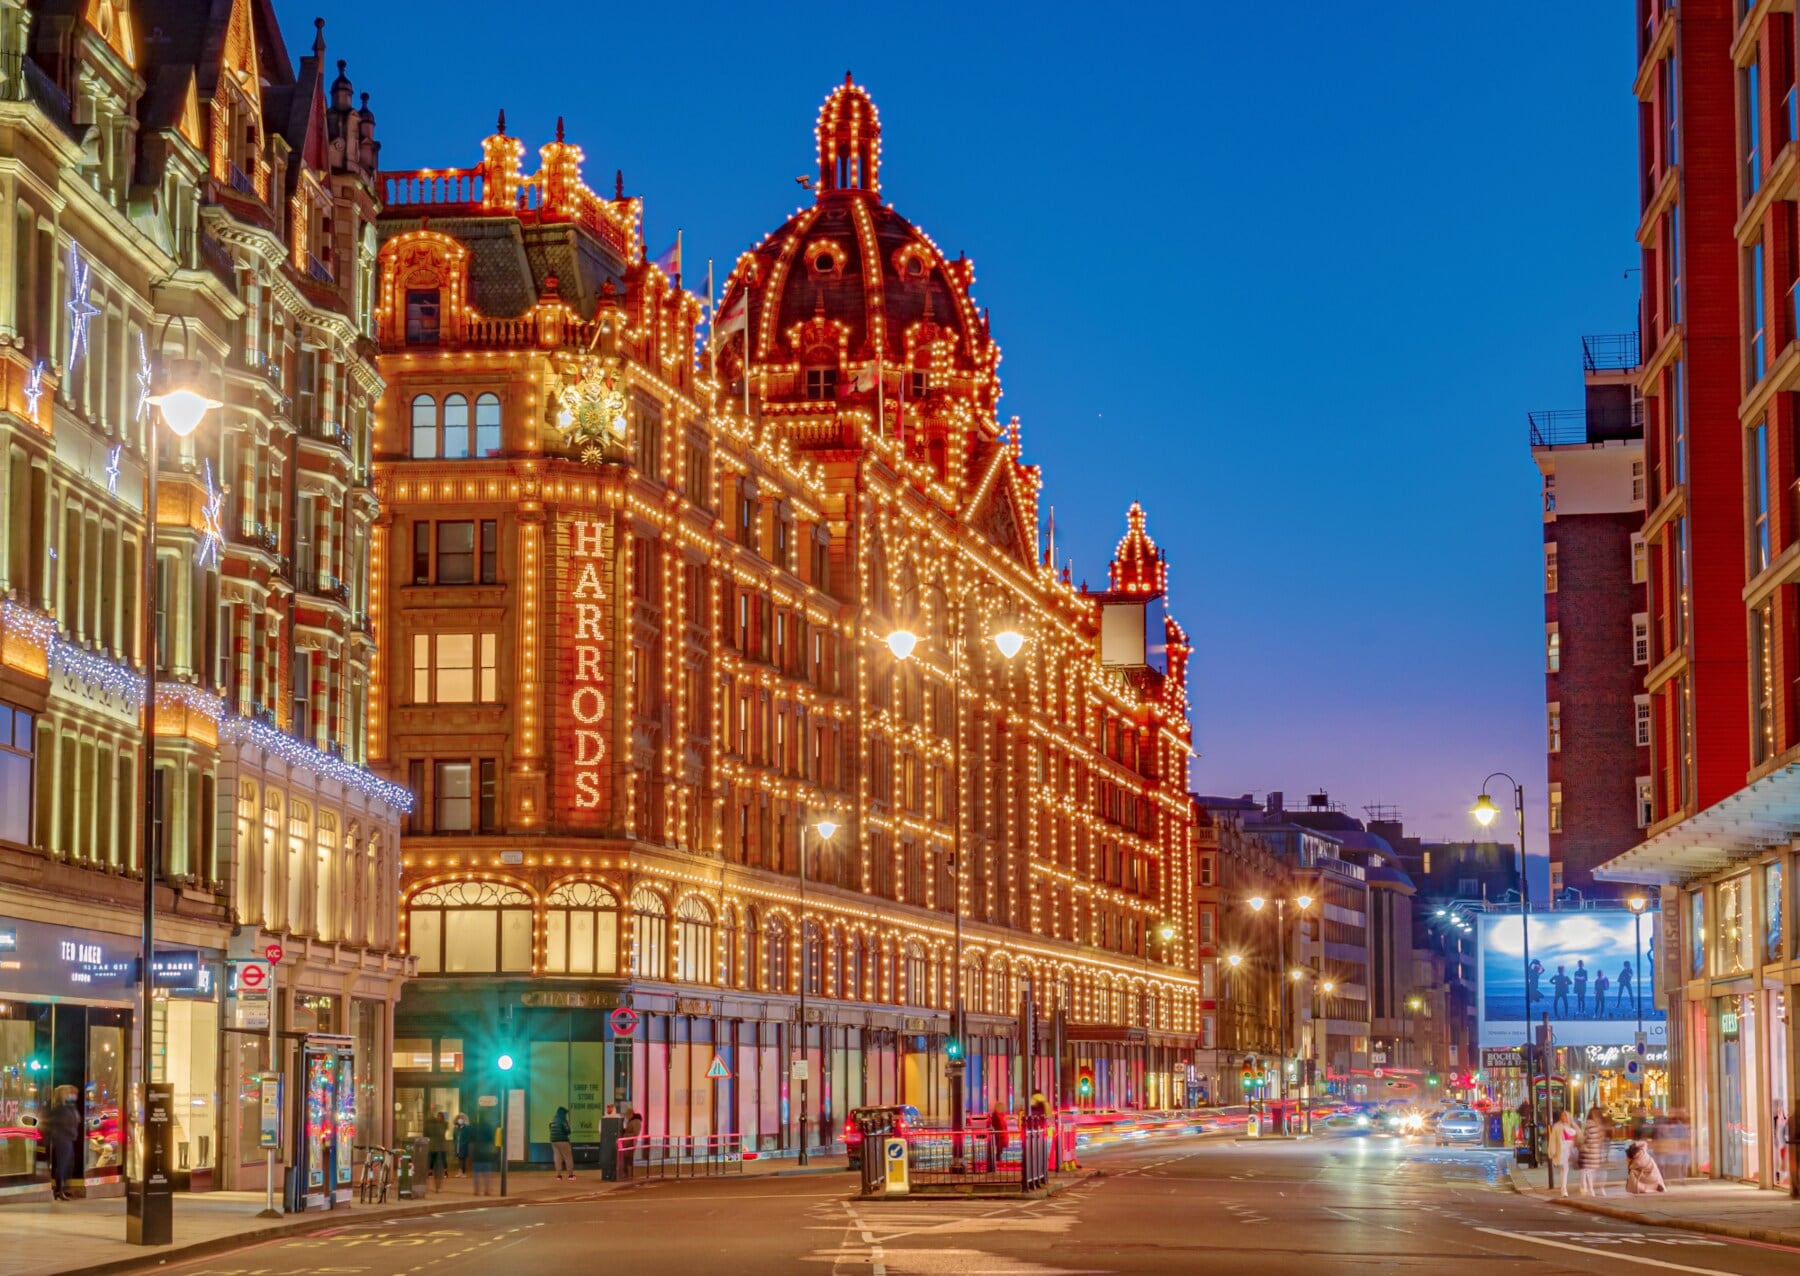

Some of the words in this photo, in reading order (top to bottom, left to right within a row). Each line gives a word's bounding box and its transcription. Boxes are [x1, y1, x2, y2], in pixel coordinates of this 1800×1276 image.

[571, 520, 607, 808] HARRODS
[61, 941, 76, 961] TED
[79, 944, 102, 964] BAKER
[267, 949, 281, 958] KC
[1721, 1014, 1738, 1032] GUESS
